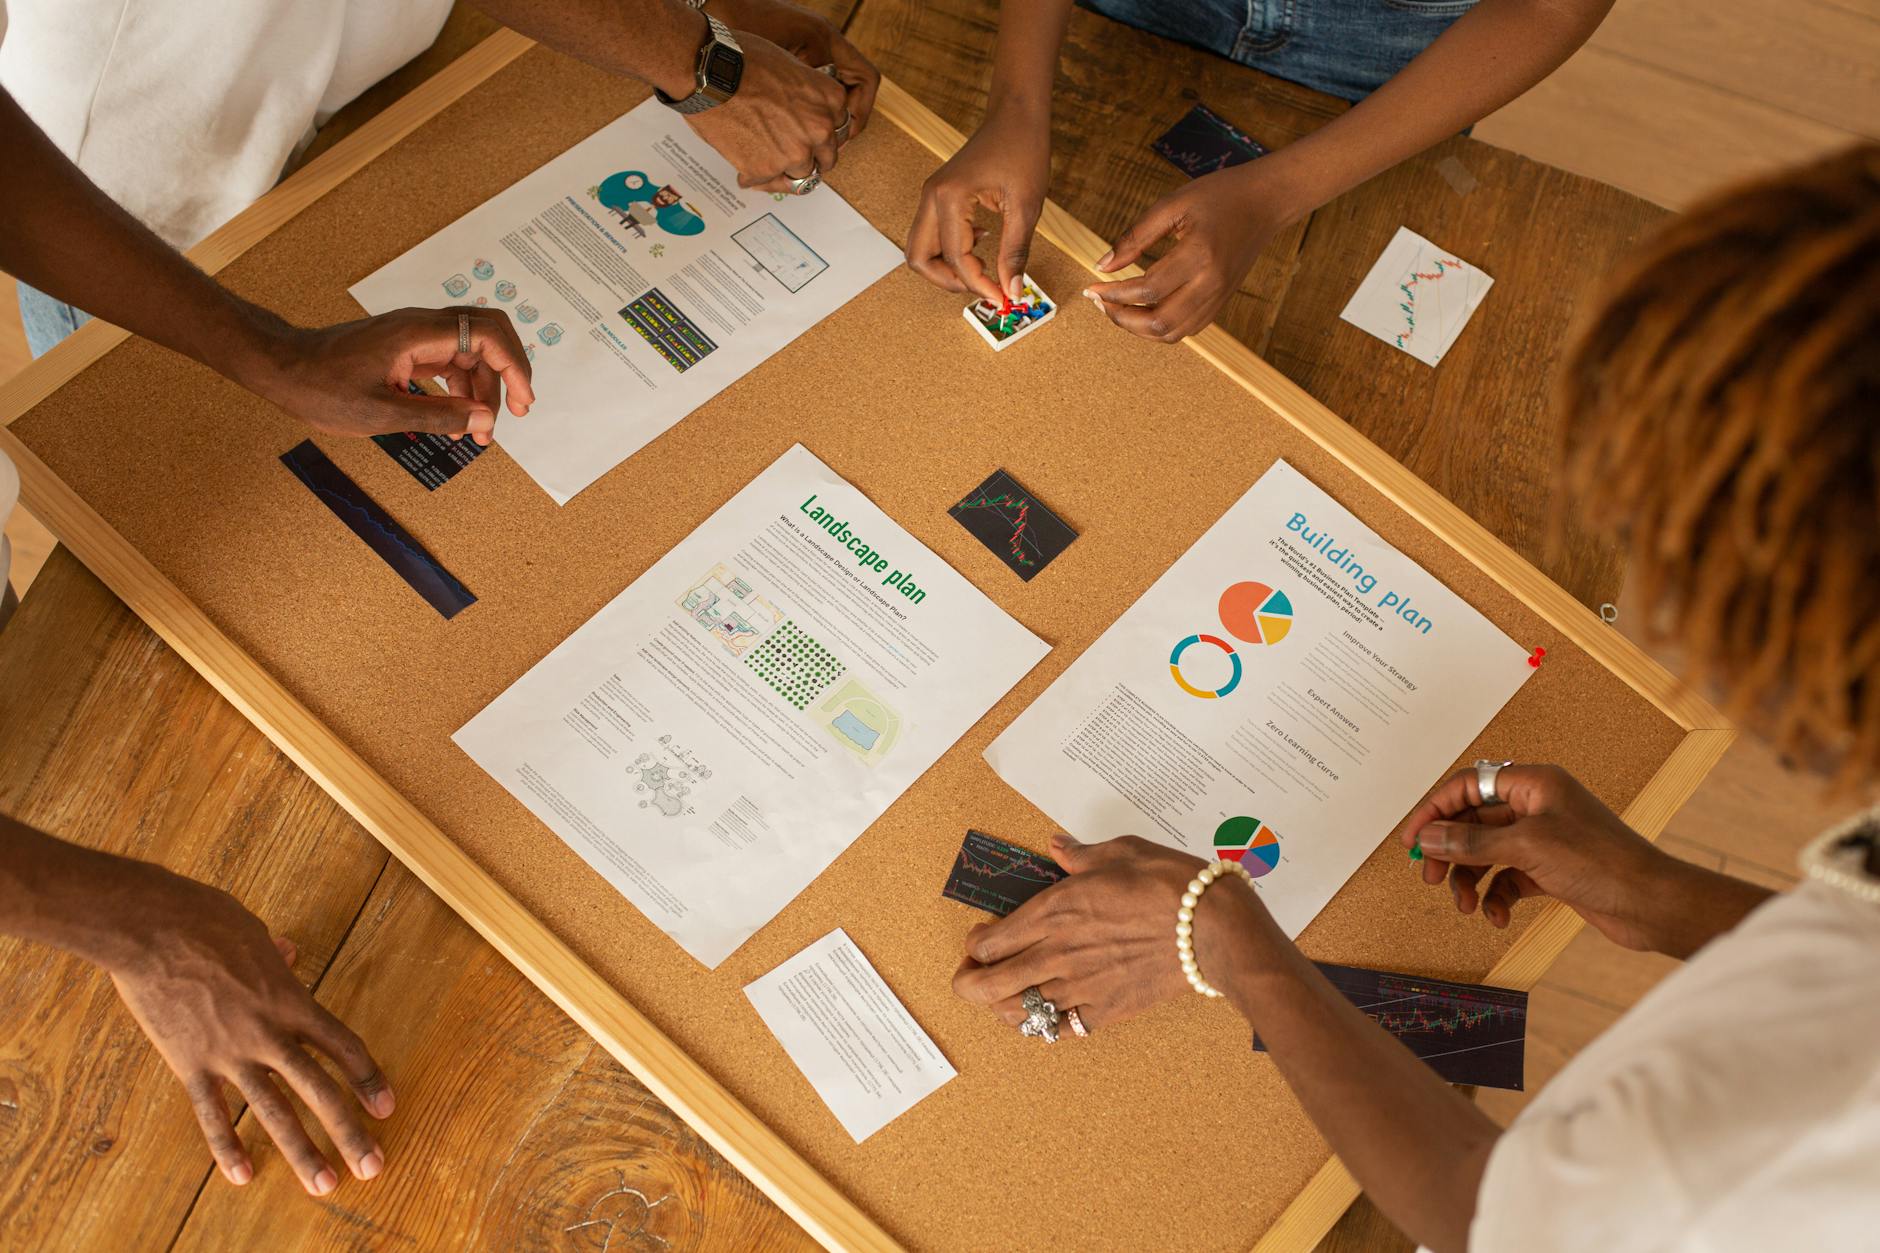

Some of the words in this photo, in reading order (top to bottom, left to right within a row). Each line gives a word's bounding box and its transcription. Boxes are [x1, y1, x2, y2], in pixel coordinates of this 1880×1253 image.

[706, 182, 717, 190] and
[736, 199, 746, 209] with
[565, 196, 601, 229] PRESENTATION
[603, 231, 627, 254] BENEFITS
[780, 514, 796, 529] What
[794, 526, 800, 534] is
[804, 535, 834, 562] Landscape
[833, 559, 854, 578] Design
[859, 581, 890, 608] Landscape
[889, 606, 907, 621] Plan?
[800, 494, 889, 573] Landscape
[881, 570, 926, 605] plan
[1277, 537, 1289, 547] The
[1288, 545, 1309, 564] World's
[1308, 562, 1317, 570] #1
[1316, 567, 1341, 589] Business
[1340, 586, 1354, 599] Plan
[1353, 596, 1379, 619] Template
[1286, 512, 1377, 594] Building
[1377, 591, 1432, 634] plan
[1278, 547, 1289, 556] the
[1288, 555, 1313, 575] quickest
[1311, 573, 1324, 584] and
[1323, 582, 1343, 599] easiest
[1342, 597, 1355, 609] way
[1354, 606, 1361, 614] to
[1360, 612, 1379, 628] create
[1280, 557, 1304, 578] winning
[1302, 575, 1327, 596] business
[1325, 594, 1341, 608] plan,
[1340, 606, 1363, 624] period!
[1343, 630, 1372, 656] Improve
[1372, 653, 1389, 668] Your
[1387, 666, 1418, 691] Strategy
[612, 710, 631, 728] Engineering
[1307, 688, 1331, 710] Expert
[1329, 707, 1360, 733] Answers
[1265, 719, 1284, 737] Zero
[1283, 734, 1317, 765] Learning
[1316, 761, 1339, 781] Curve
